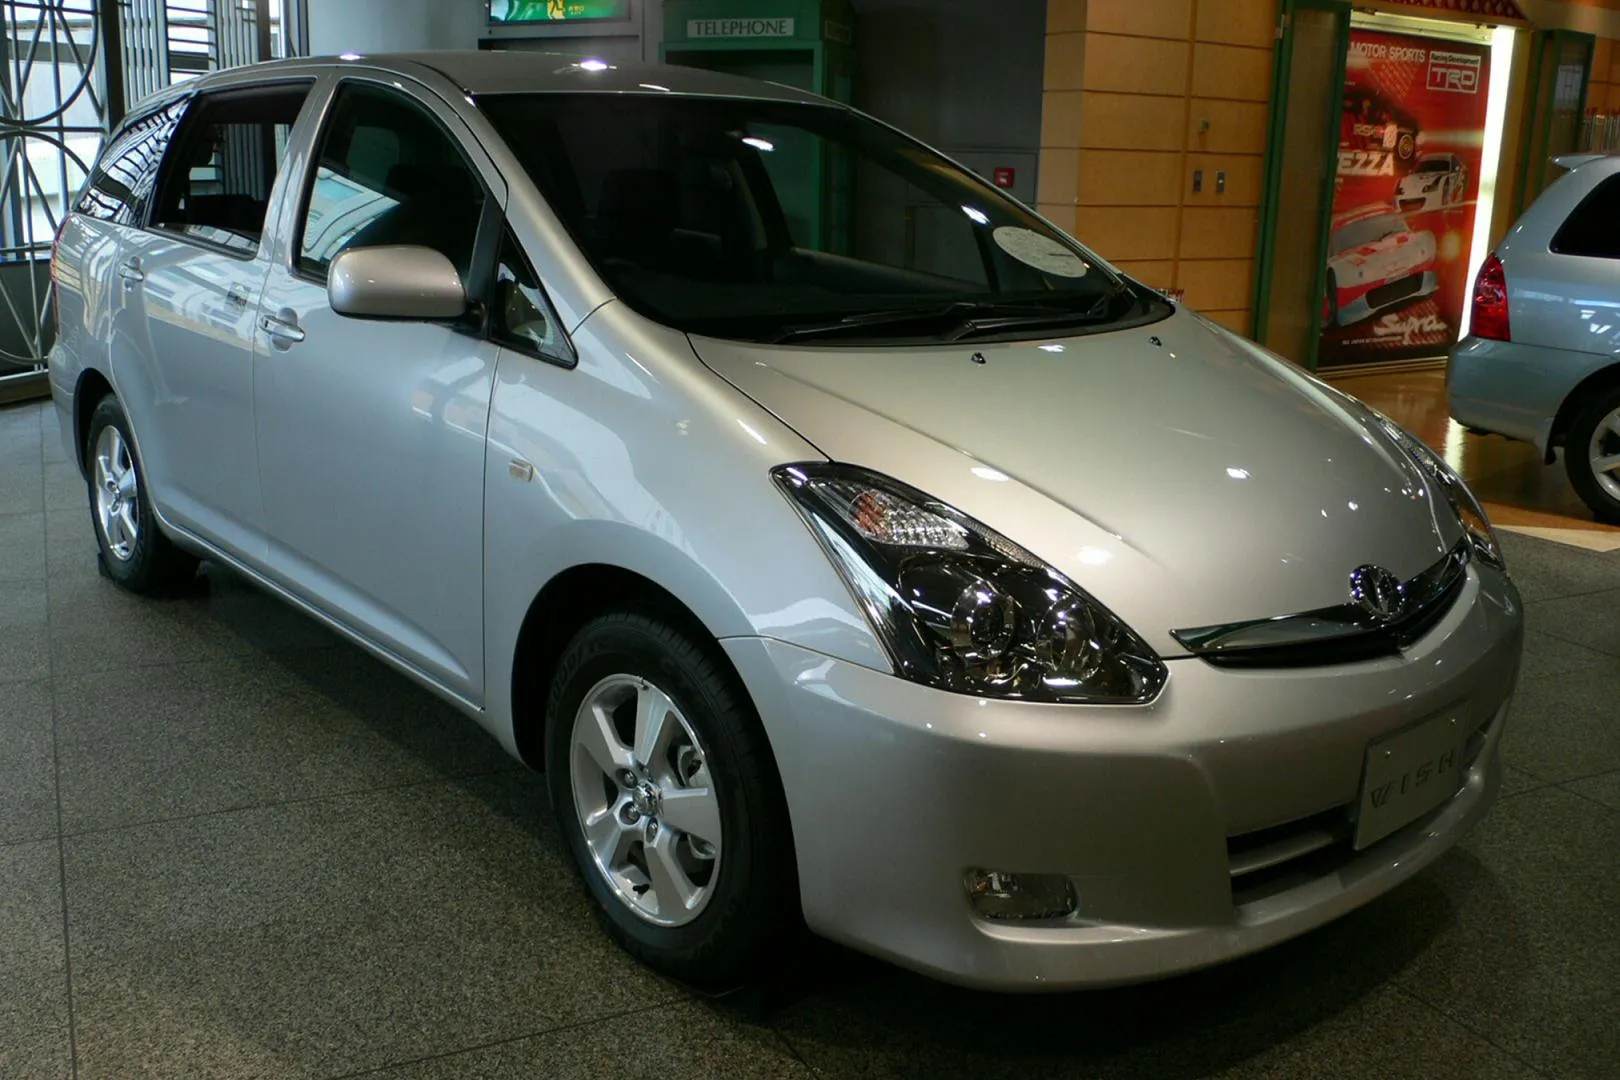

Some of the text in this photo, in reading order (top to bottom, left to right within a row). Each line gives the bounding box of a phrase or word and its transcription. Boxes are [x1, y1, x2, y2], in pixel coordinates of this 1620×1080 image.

[695, 20, 787, 36] TELEPHONE
[1350, 42, 1426, 63] MOTOR SPORTS
[1431, 67, 1475, 90] TRD
[1337, 151, 1395, 177] EZZA
[1374, 314, 1448, 345] Supra
[1371, 748, 1456, 809] WISH
